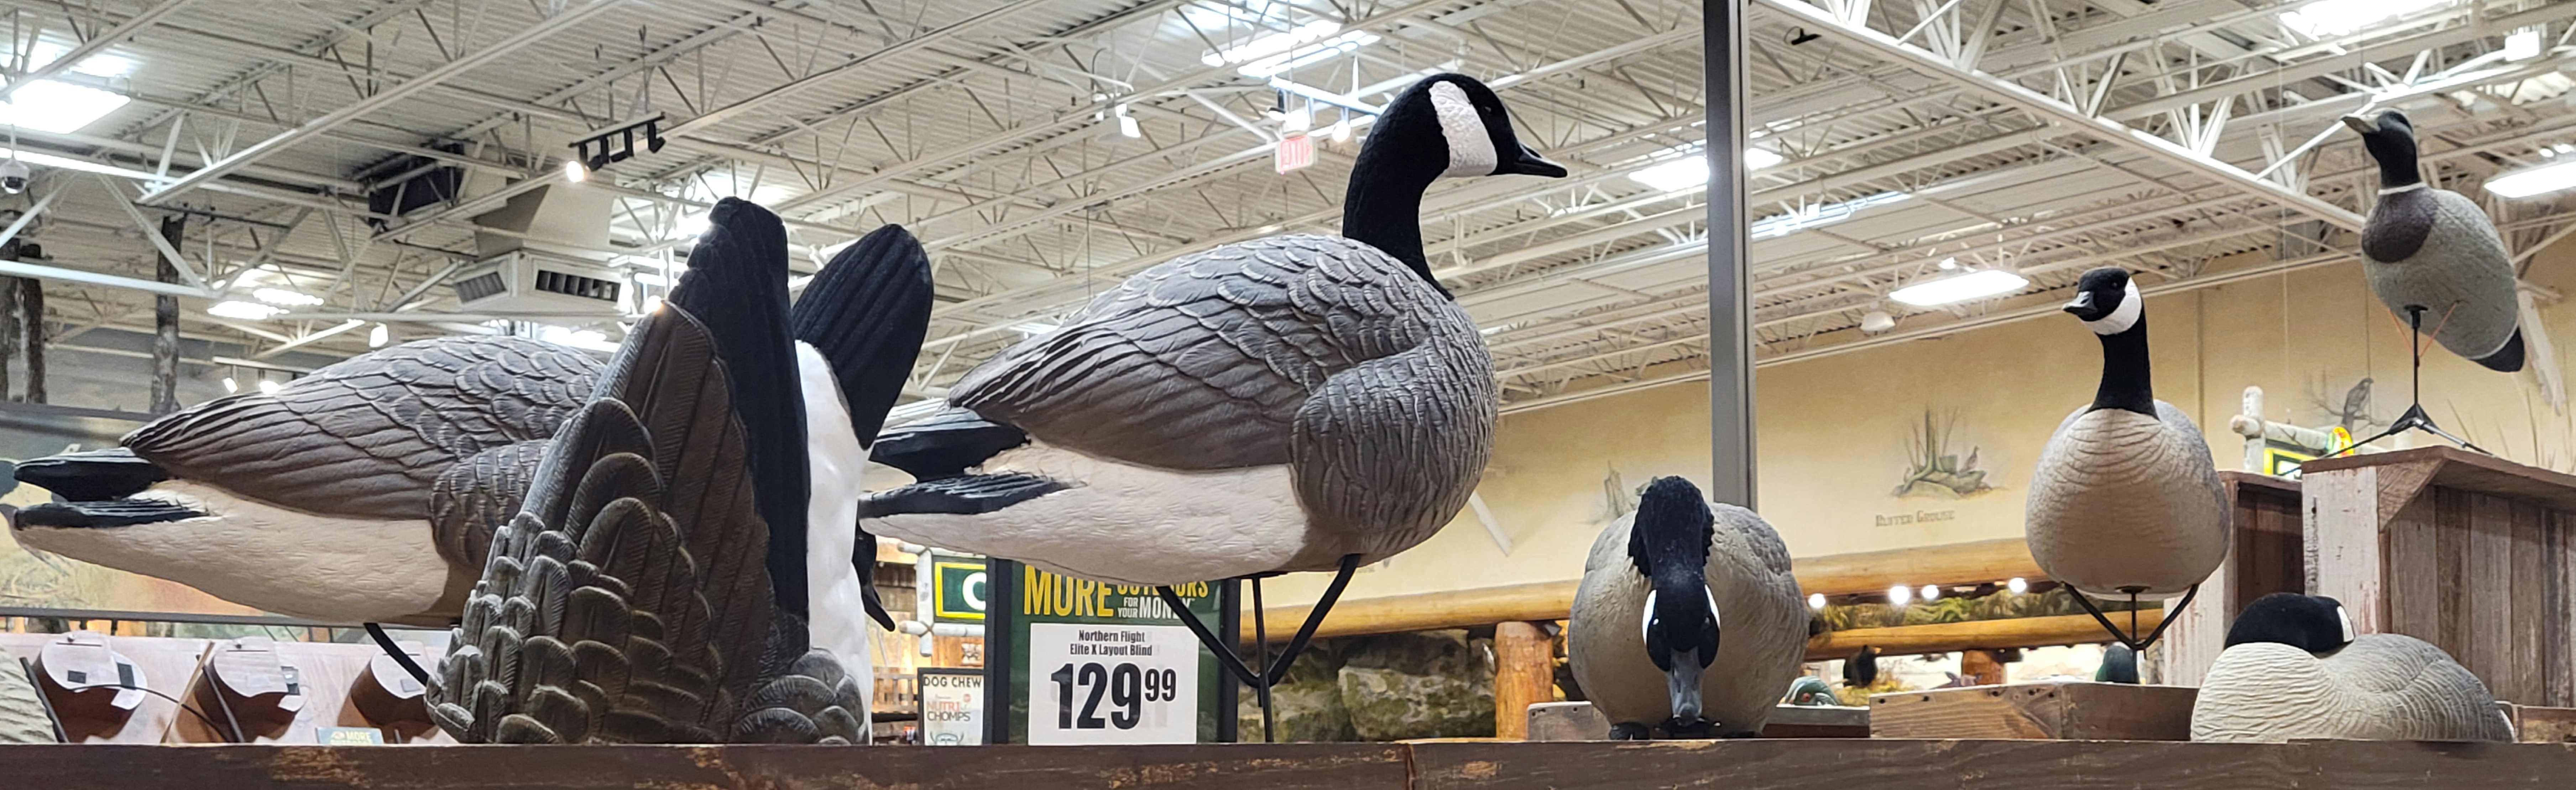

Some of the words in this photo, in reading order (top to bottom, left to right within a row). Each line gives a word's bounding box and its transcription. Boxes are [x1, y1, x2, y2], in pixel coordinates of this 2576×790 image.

[1024, 564, 1114, 616] MORE
[1118, 607, 1138, 618] YOUR
[1139, 596, 1191, 619] MON
[1124, 597, 1138, 607] FOR
[1079, 630, 1118, 641] Northern
[1121, 631, 1145, 643] Flight
[1070, 643, 1090, 655] Elite
[1092, 644, 1097, 655] X
[1099, 644, 1128, 656] Layout
[1130, 644, 1152, 656] Blind
[924, 677, 947, 687] DOG
[951, 677, 981, 688] CHEW
[1051, 663, 1141, 730] 129
[1145, 669, 1176, 701] 99
[927, 701, 961, 712] NUTRI
[927, 711, 971, 722] CHOMPS
